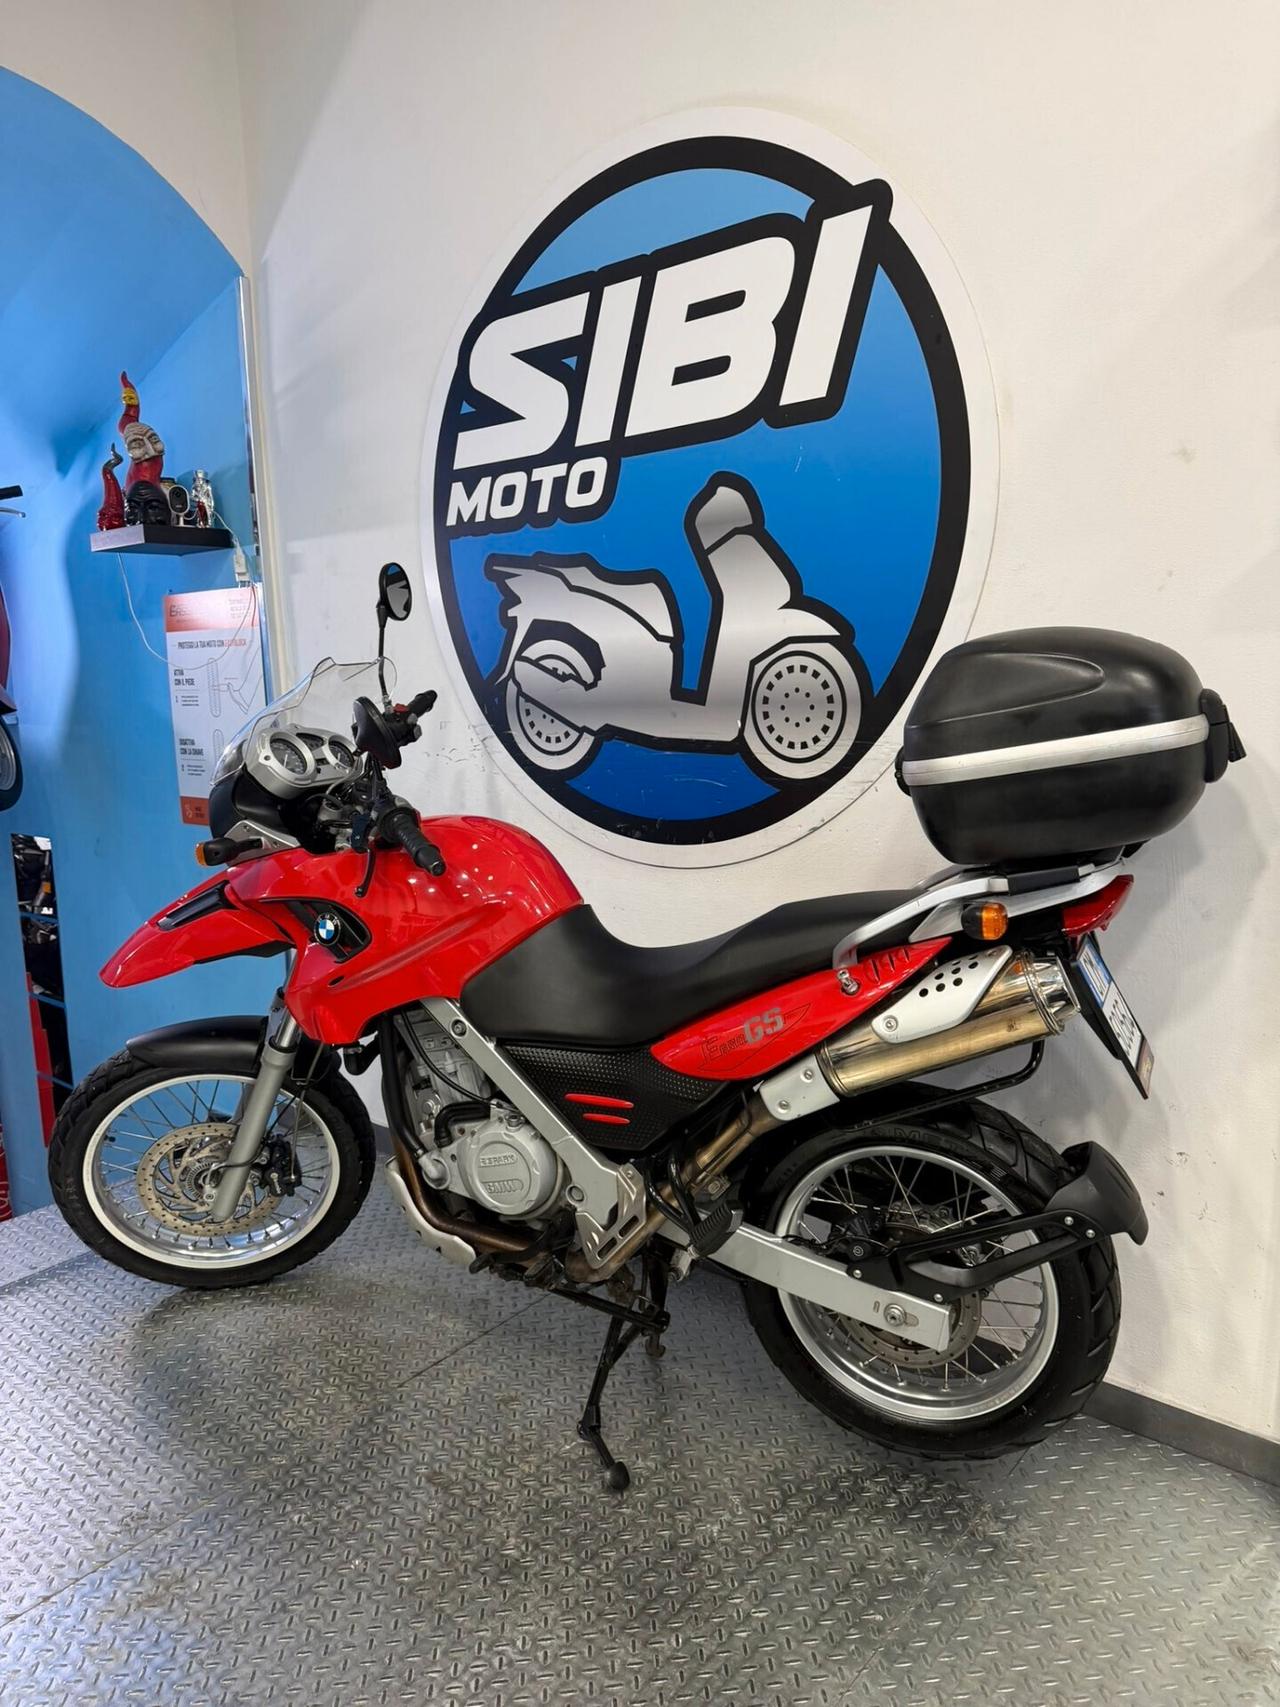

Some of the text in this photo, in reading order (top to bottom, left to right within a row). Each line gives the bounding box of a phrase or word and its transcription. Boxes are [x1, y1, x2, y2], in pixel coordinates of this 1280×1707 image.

[453, 204, 874, 470] SIBI
[446, 457, 608, 527] MOTO
[744, 1007, 784, 1044] GS
